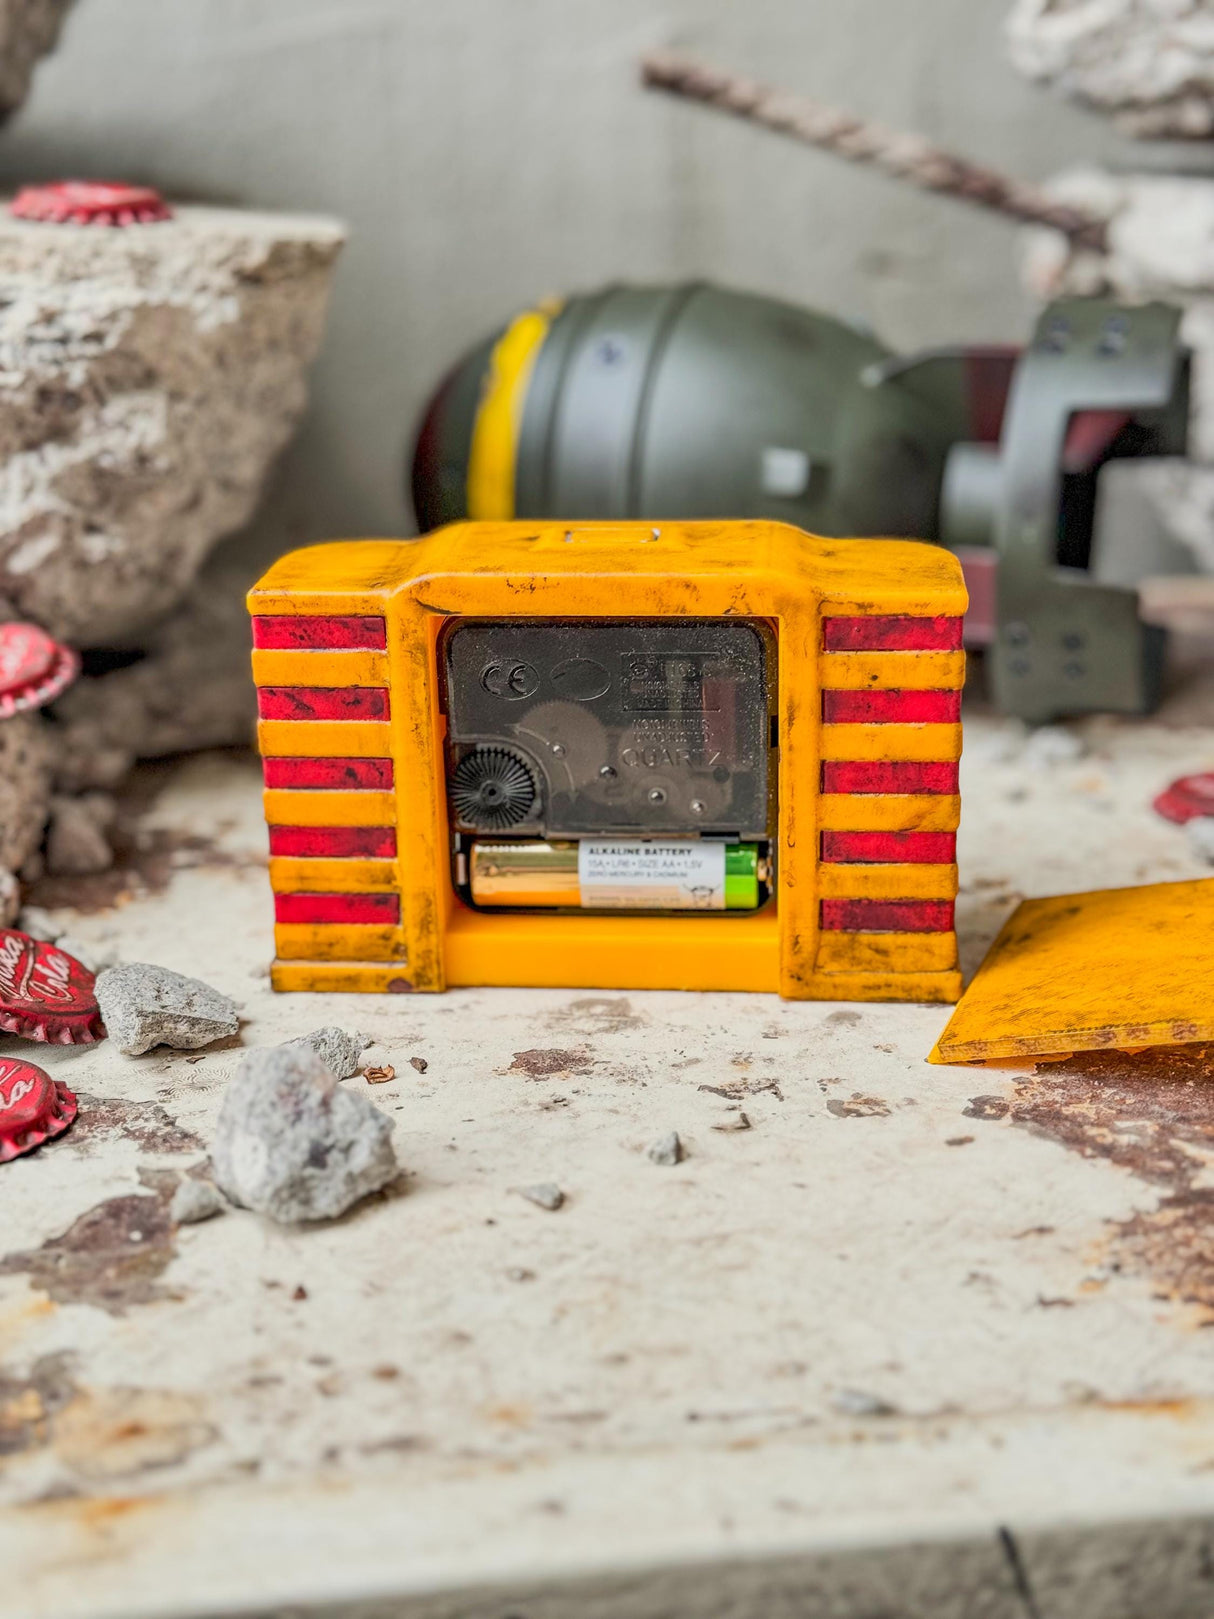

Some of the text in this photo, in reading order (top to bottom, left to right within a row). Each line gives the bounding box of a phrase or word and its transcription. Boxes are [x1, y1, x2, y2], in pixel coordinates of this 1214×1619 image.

[622, 748, 722, 767] QUARTZ
[588, 848, 693, 856] ALKALINE BATTERY
[29, 953, 74, 1001] Cola
